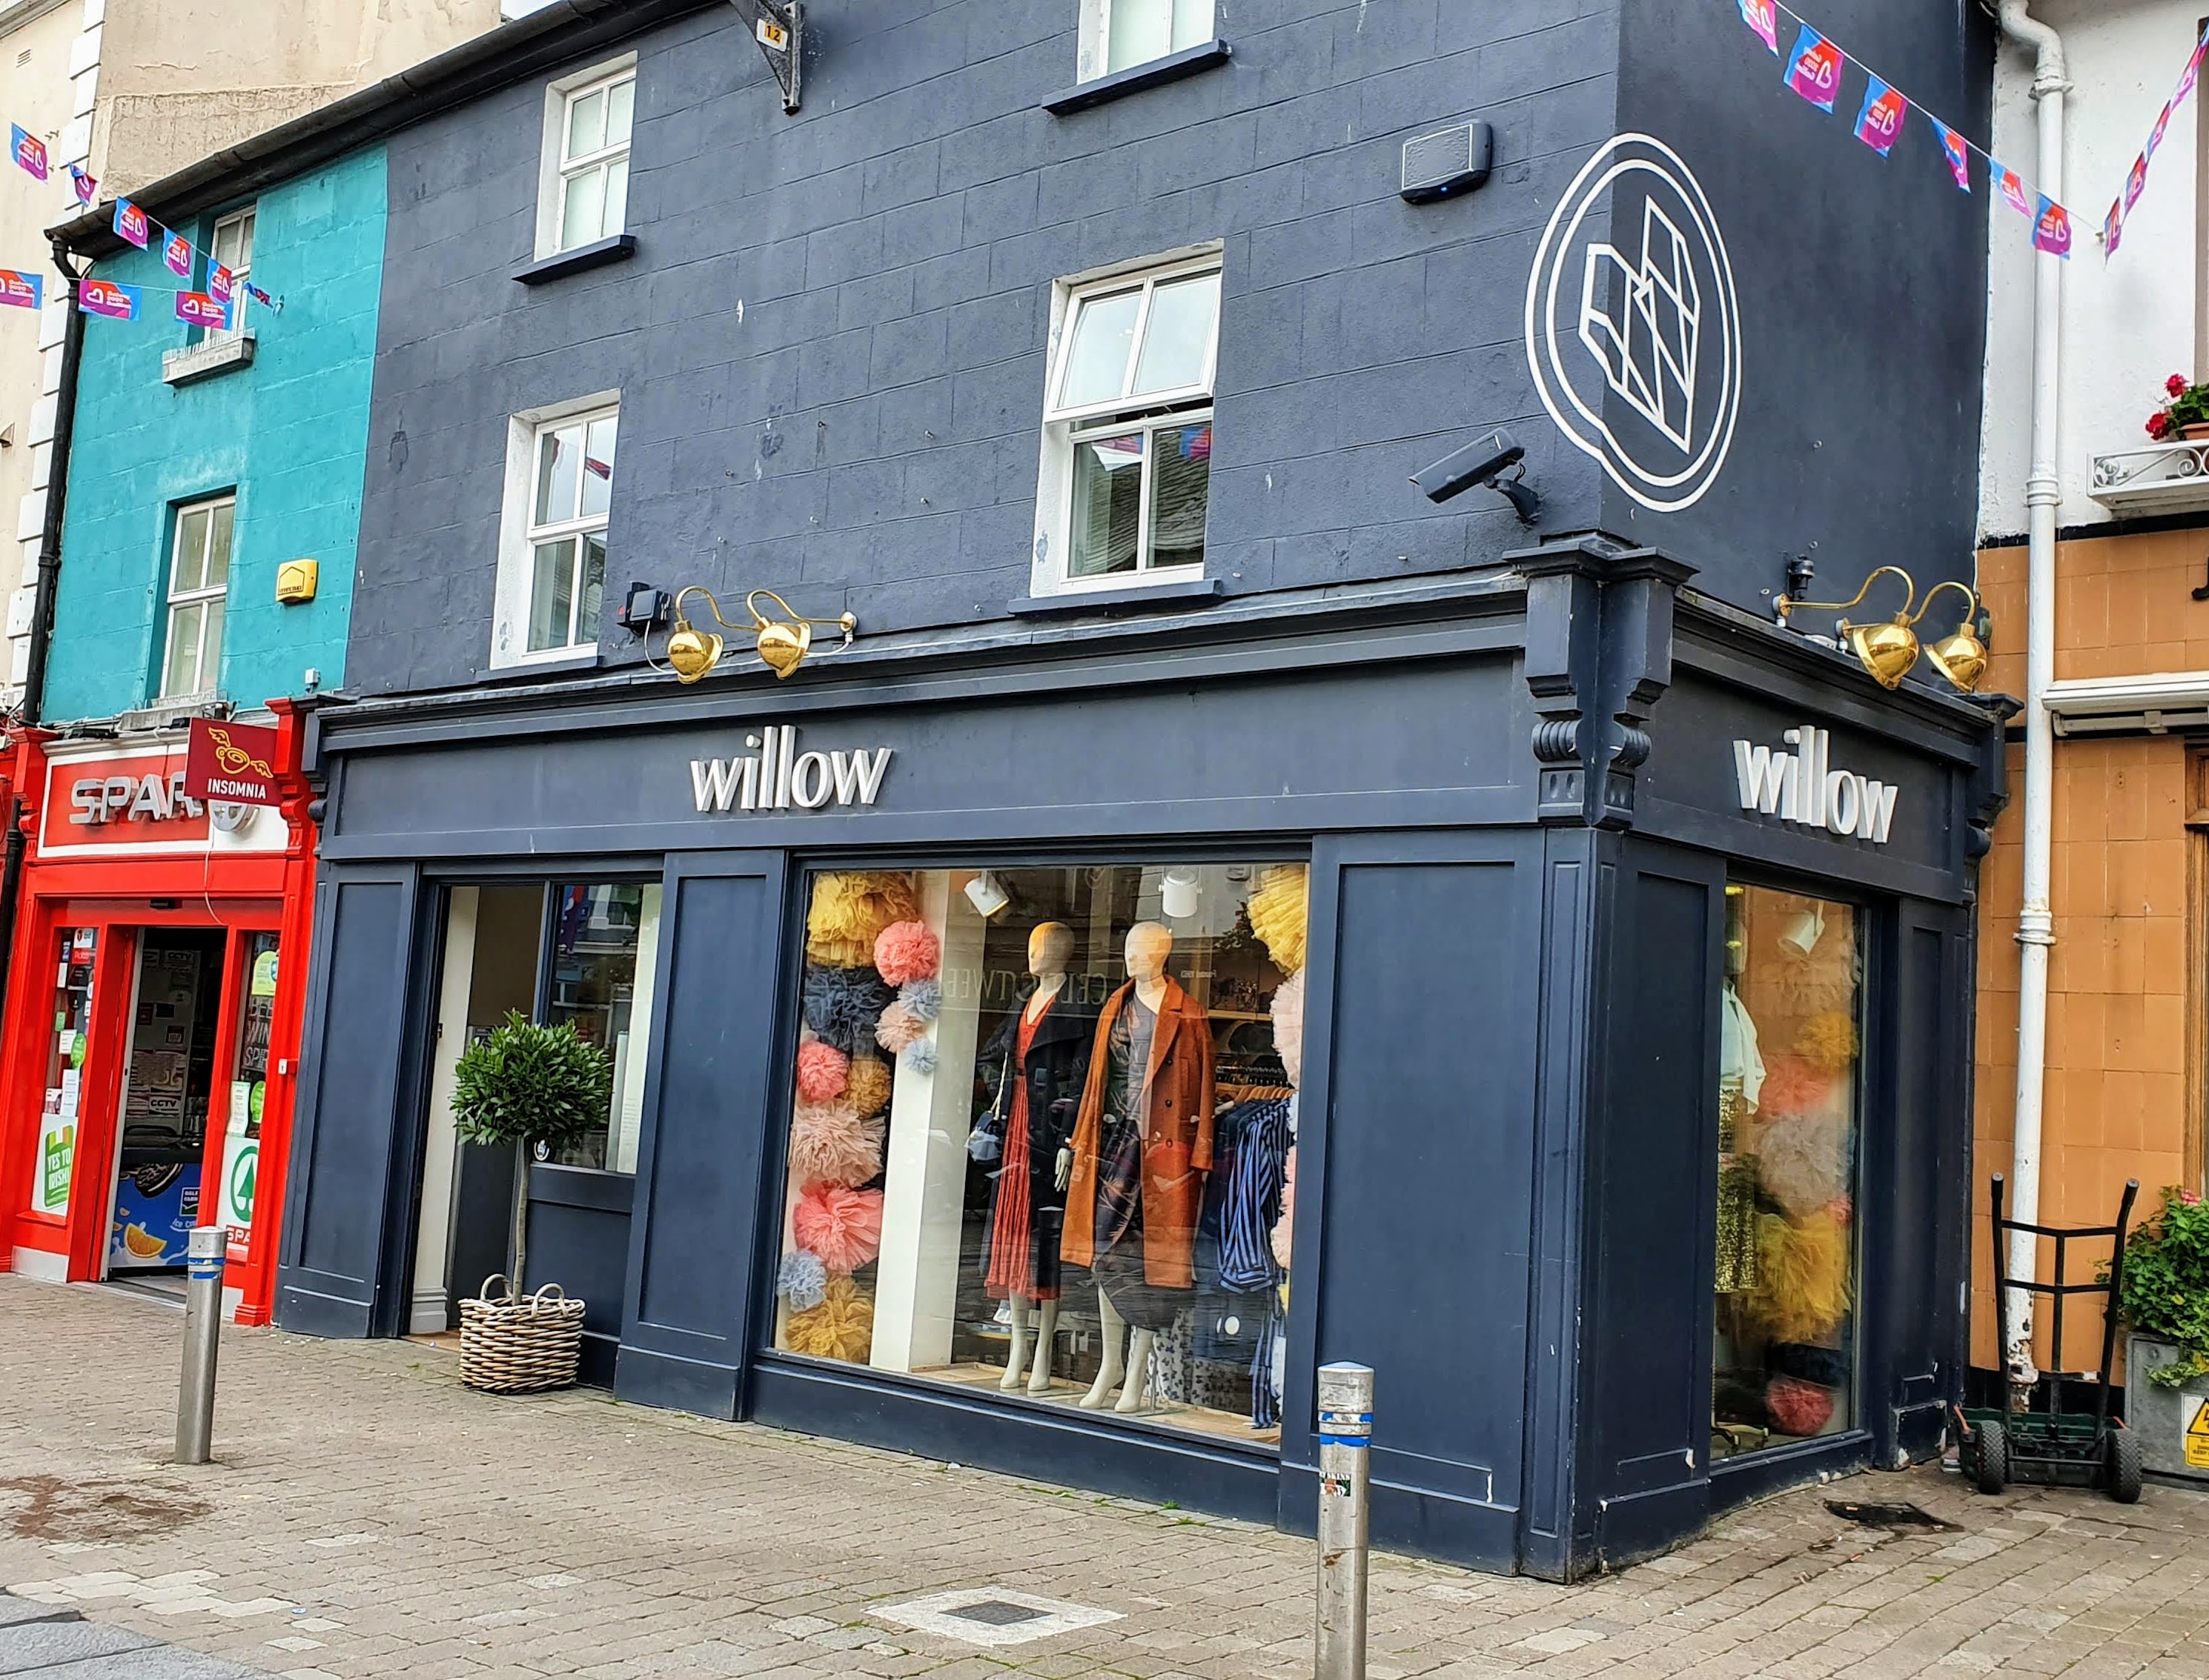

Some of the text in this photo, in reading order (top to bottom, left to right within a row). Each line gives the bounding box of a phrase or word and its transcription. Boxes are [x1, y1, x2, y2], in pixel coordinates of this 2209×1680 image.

[766, 25, 781, 43] 12
[690, 725, 892, 811] willow
[208, 778, 267, 800] INSOMNIA
[1733, 725, 1898, 843] willow
[69, 771, 203, 824] SPAR
[168, 952, 192, 961] CCTV
[247, 1020, 271, 1046] WIN
[150, 1100, 177, 1108] CCTV
[47, 1147, 72, 1172] YES TO
[226, 1226, 251, 1244] SPA
